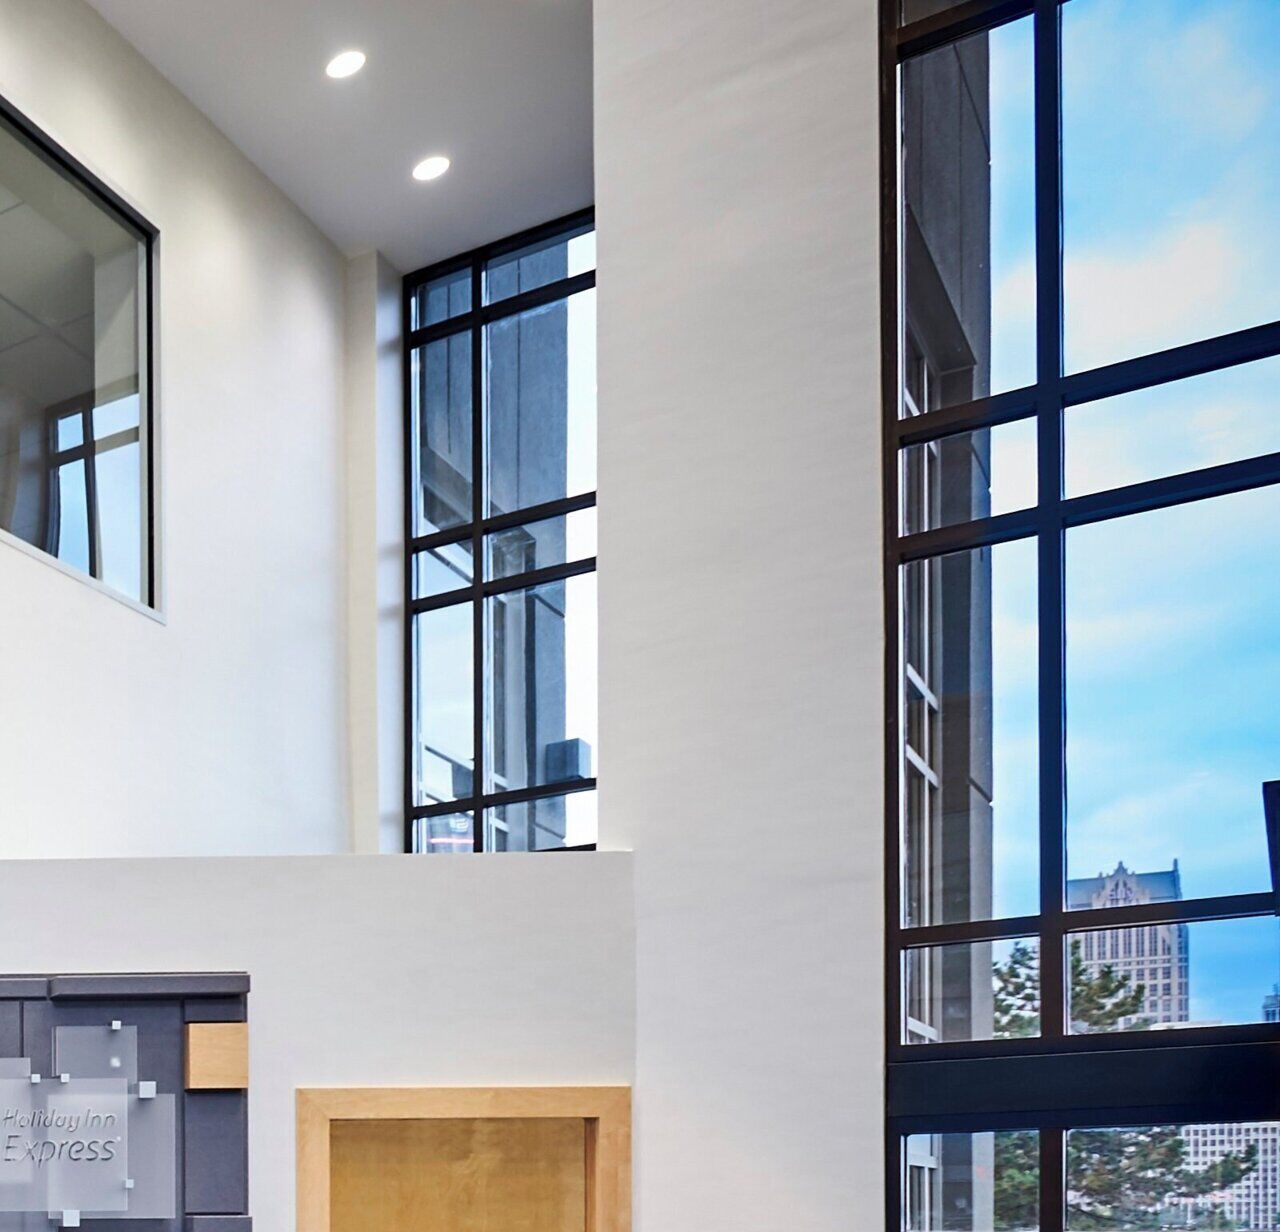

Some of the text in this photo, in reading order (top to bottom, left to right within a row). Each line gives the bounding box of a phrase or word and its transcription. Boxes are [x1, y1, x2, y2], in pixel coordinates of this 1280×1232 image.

[2, 1108, 116, 1132] Holiday Inn
[3, 1134, 117, 1168] Express
